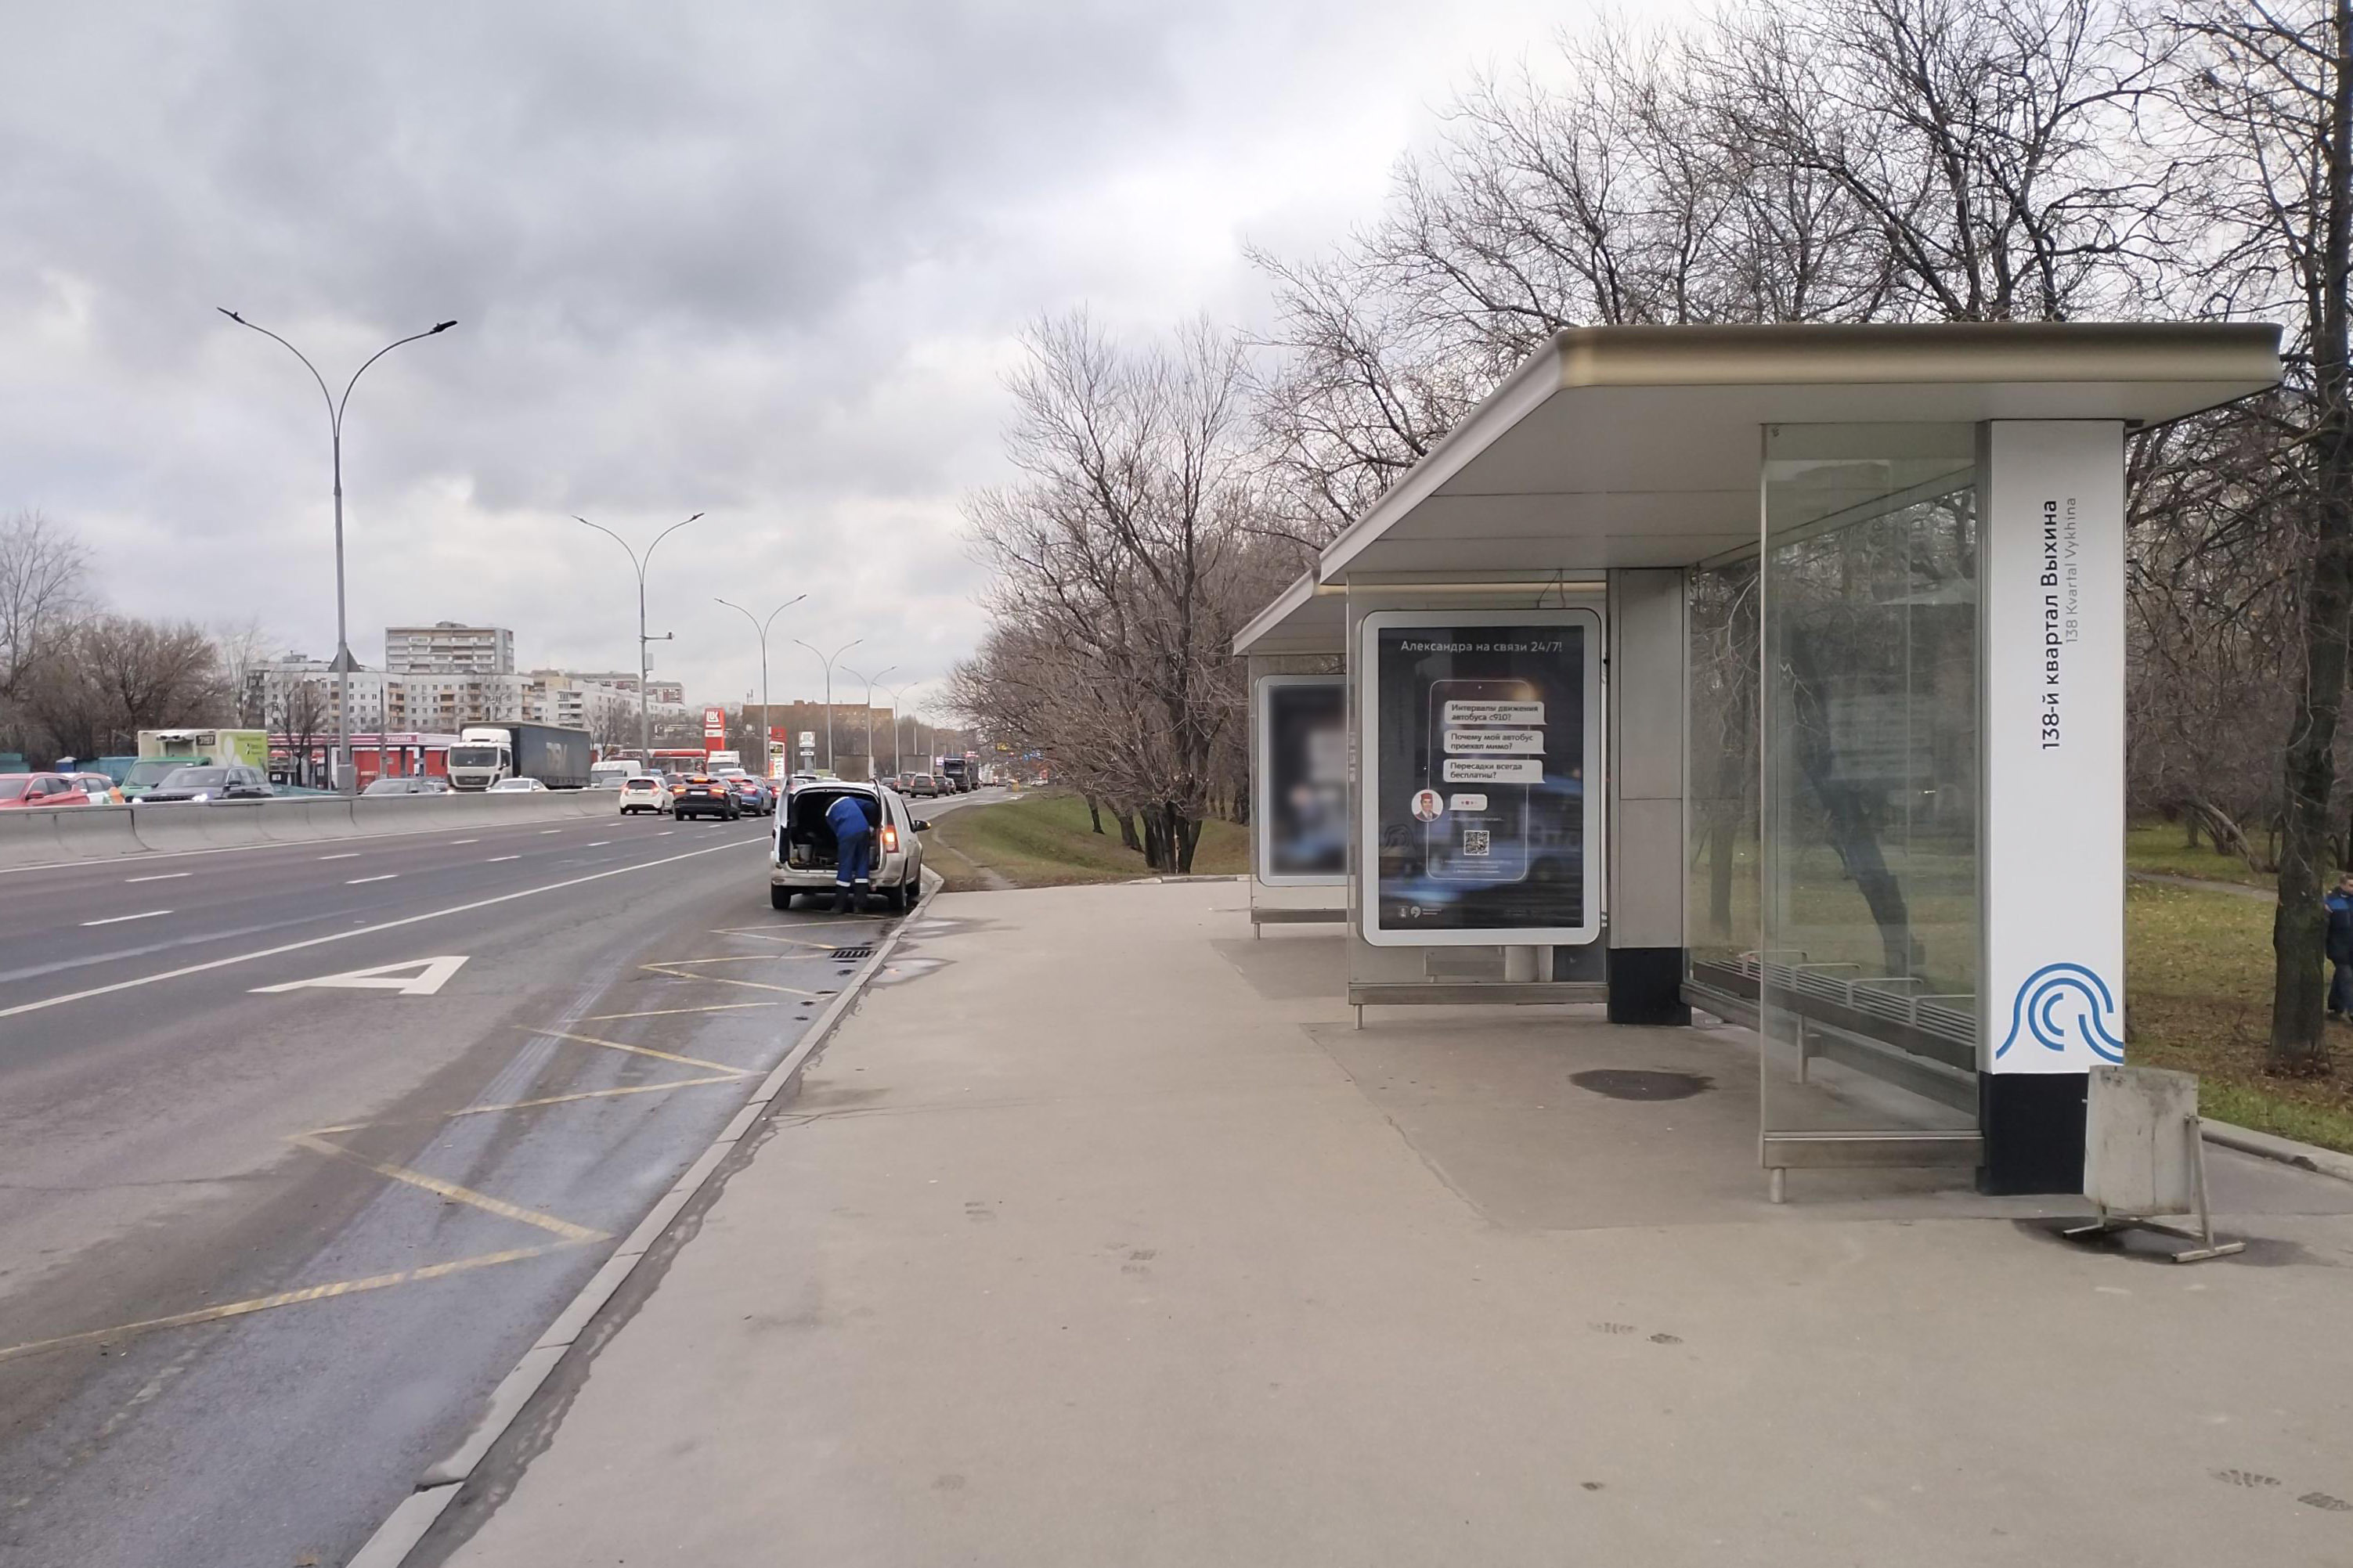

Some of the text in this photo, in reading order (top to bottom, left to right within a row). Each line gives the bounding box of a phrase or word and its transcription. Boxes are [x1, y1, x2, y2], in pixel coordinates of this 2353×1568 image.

[2064, 497, 2080, 643] 138 Kvartal Vykhina
[2041, 499, 2062, 750] 138-й квартал Выхина
[1401, 640, 1562, 654] Александра на связи 24/7!
[1452, 713, 1487, 722] автобуса
[1451, 733, 1481, 741] Почему
[1502, 734, 1533, 742] автобус
